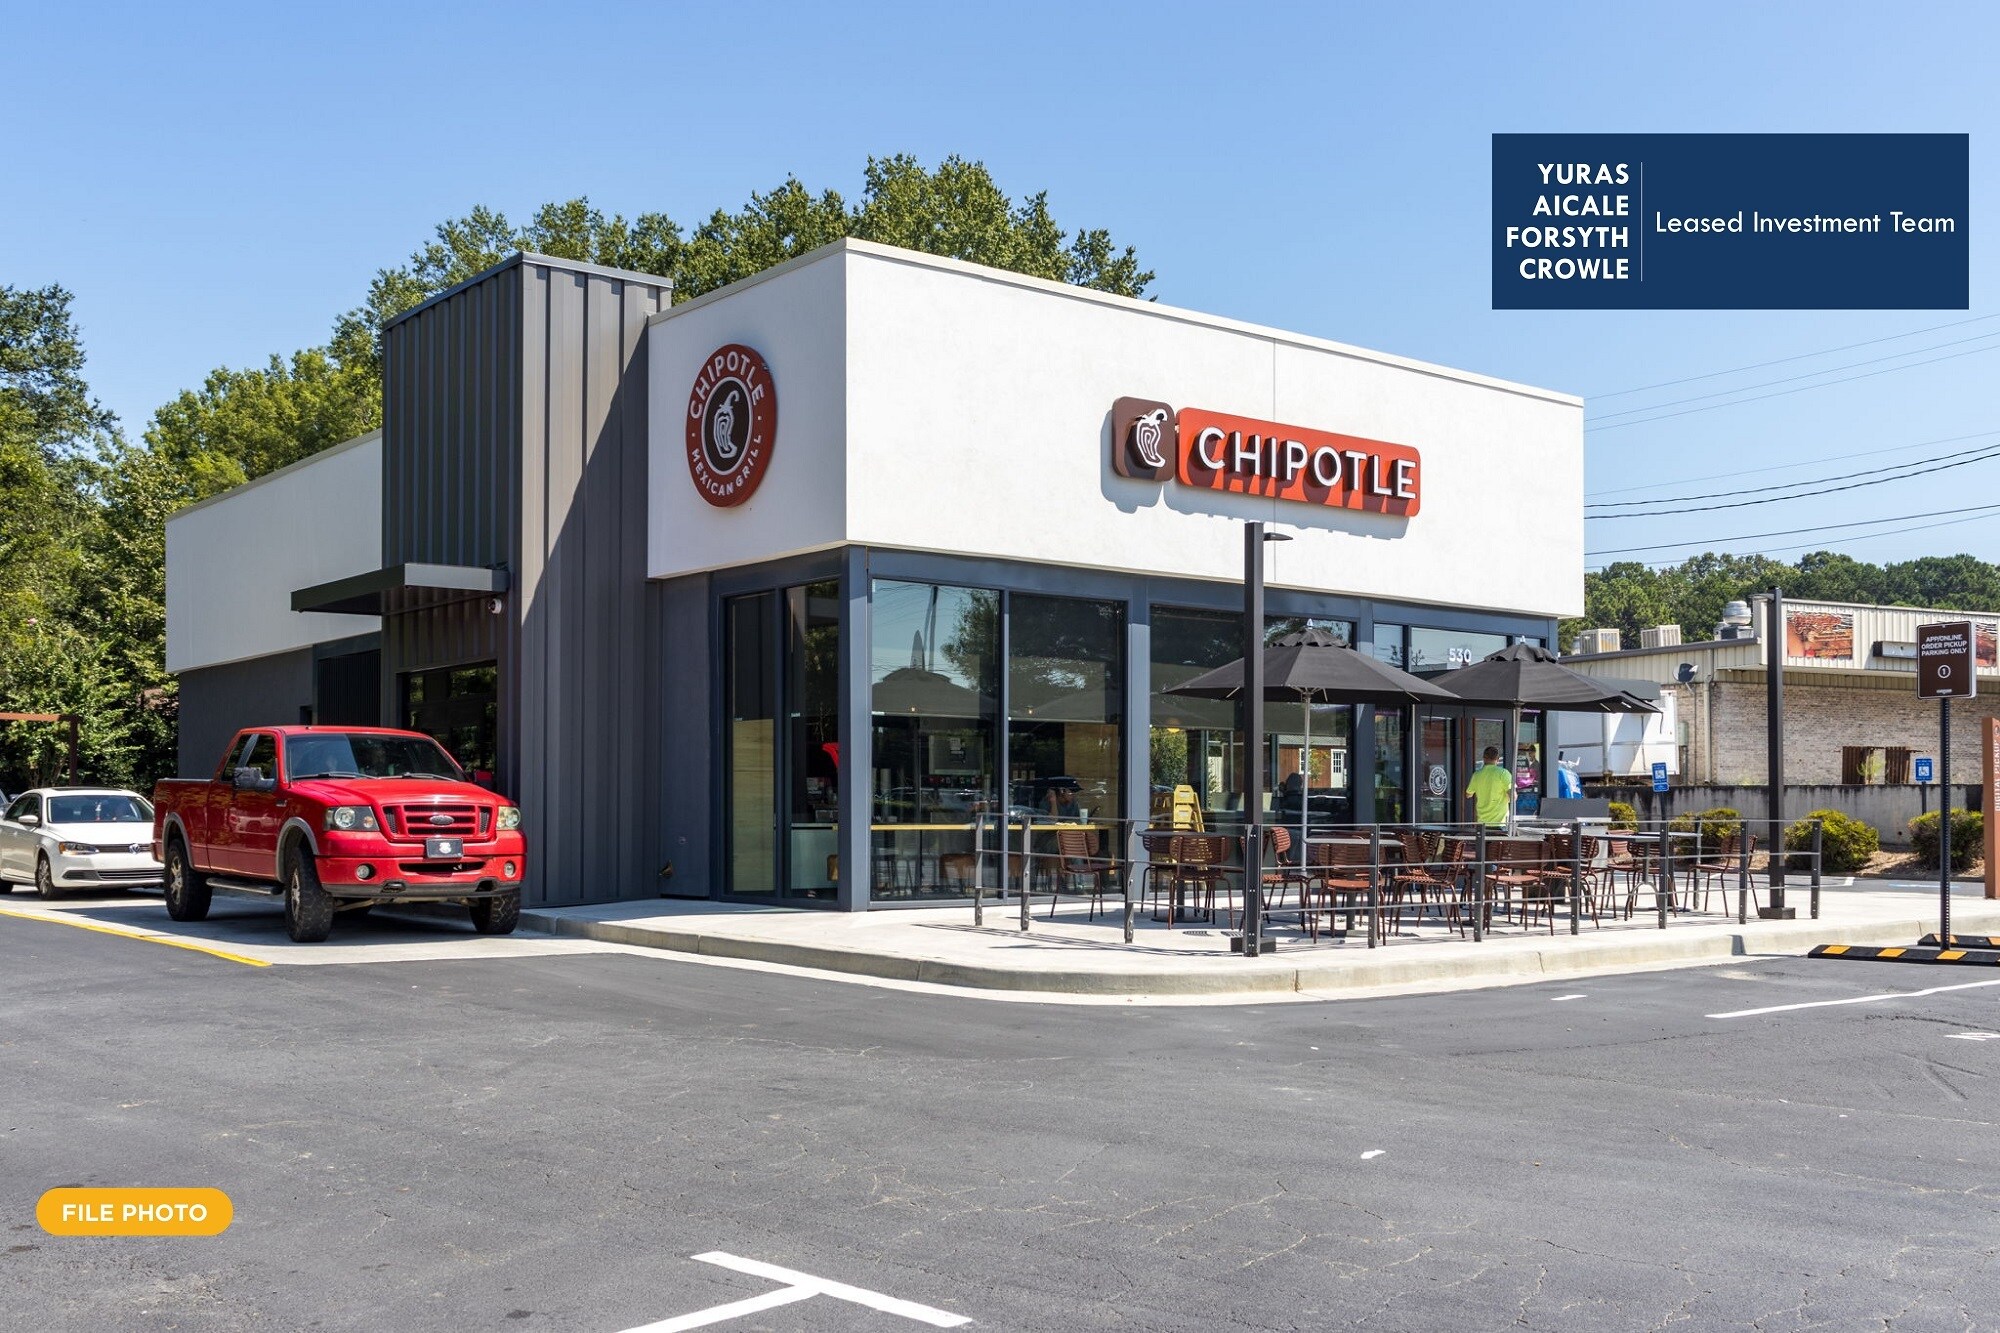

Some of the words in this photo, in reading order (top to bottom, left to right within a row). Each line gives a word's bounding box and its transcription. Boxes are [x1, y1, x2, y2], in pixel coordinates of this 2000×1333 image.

[690, 351, 765, 419] CHIPOTLE
[691, 448, 734, 496] MEXICAN
[735, 434, 762, 487] GRILL
[1198, 425, 1417, 499] CHIPOTLE
[1921, 642, 1943, 650] ORDER
[1943, 640, 1968, 649] PICKUP
[1926, 634, 1963, 643] APP/ONLINE
[1448, 647, 1472, 663] 530
[1921, 649, 1949, 657] PARKING
